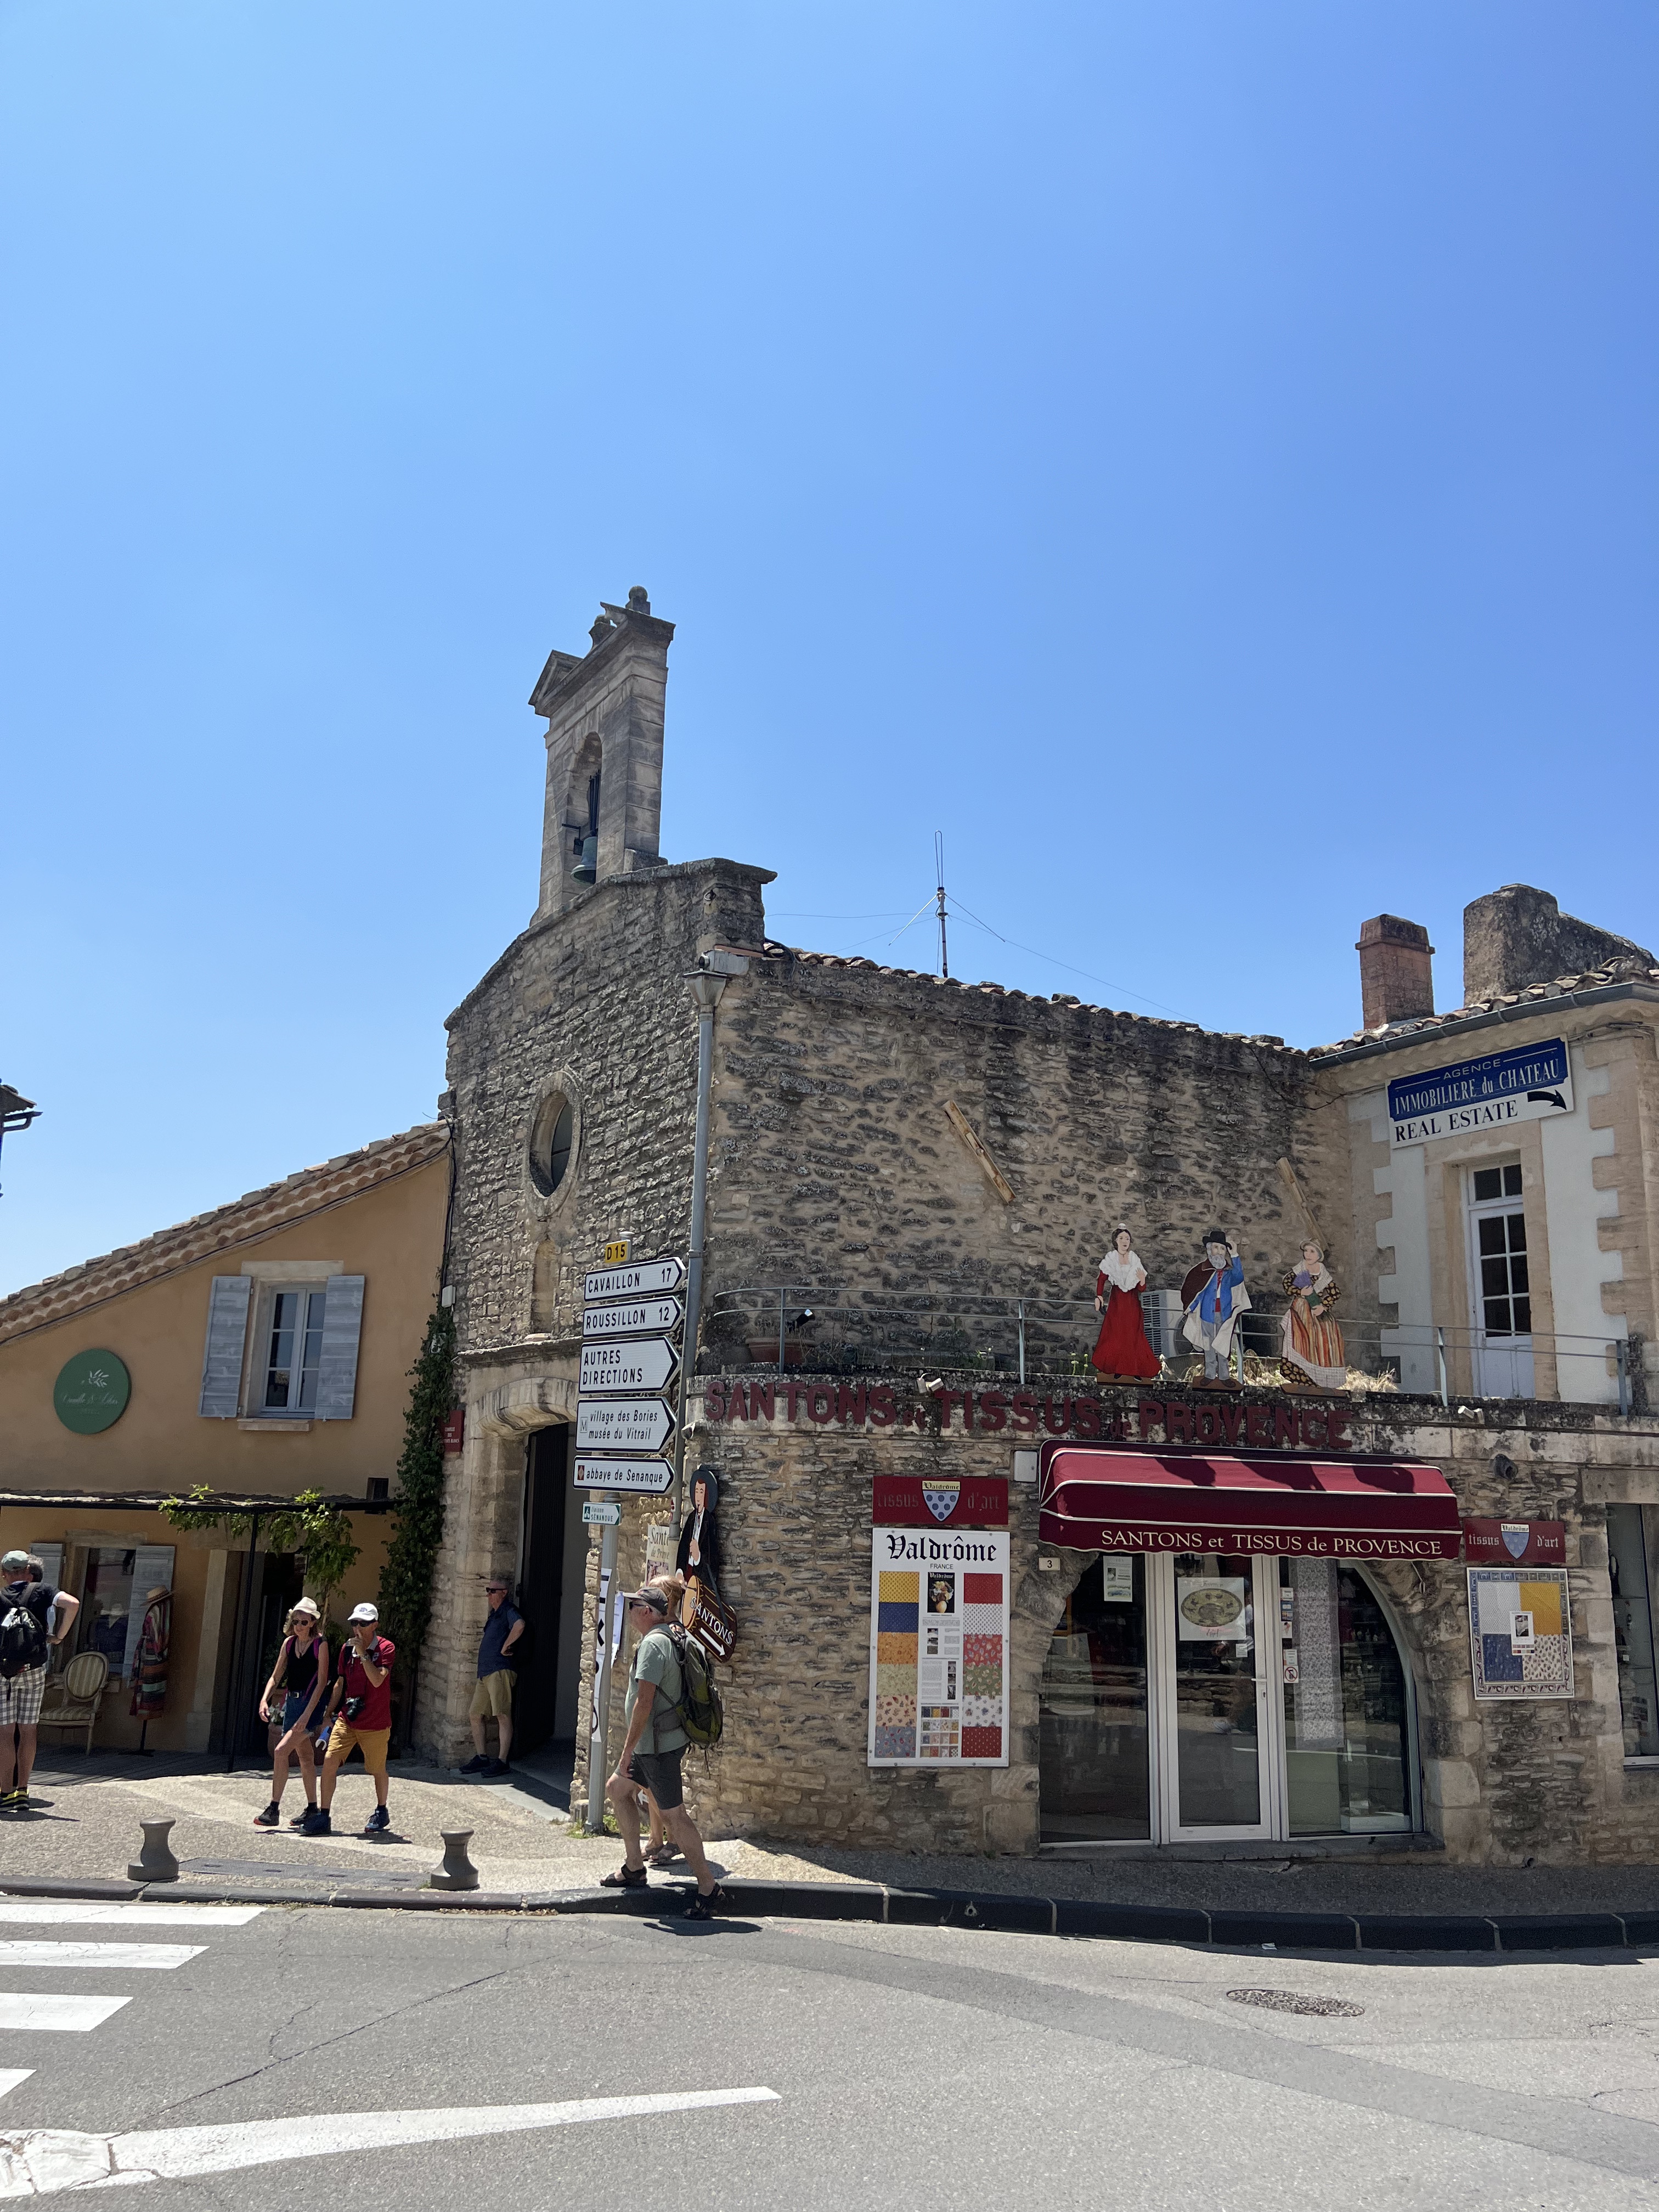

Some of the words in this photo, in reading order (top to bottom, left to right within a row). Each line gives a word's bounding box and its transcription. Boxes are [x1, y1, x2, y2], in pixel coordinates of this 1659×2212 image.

[1443, 1058, 1501, 1080] AGENCE
[1395, 1079, 1477, 1115] IMMOBILIERE
[1481, 1076, 1494, 1094] du
[1499, 1058, 1559, 1090] CHATEAU
[1394, 1118, 1441, 1142] REAL
[1448, 1099, 1518, 1131] ESTATE
[607, 1246, 612, 1260] D
[615, 1244, 625, 1259] 15
[588, 1272, 640, 1294] CAVAILLON
[661, 1267, 672, 1283] 17
[586, 1308, 646, 1329] ROUSSILLON
[659, 1306, 669, 1322] 12
[584, 1350, 621, 1366] AUTRES
[583, 1368, 643, 1385] DIRECTIONS
[590, 1410, 614, 1425] village
[618, 1410, 630, 1422] des
[634, 1409, 658, 1422] Bories
[706, 1380, 897, 1426] SANTONS
[902, 1408, 926, 1430] et
[934, 1389, 1101, 1436] TISSUS
[1138, 1400, 1353, 1448] PROVENCE
[588, 1427, 611, 1439] musée
[614, 1427, 623, 1439] du
[627, 1427, 651, 1440] Vitrail
[586, 1468, 611, 1482] abbaye
[614, 1469, 623, 1481] de
[627, 1469, 663, 1486] Senanque
[886, 1534, 997, 1561] Valdrôme
[1102, 1530, 1203, 1548] SANTONS
[1208, 1537, 1224, 1548] et
[1232, 1534, 1302, 1550] TISSUS
[1307, 1537, 1328, 1551] de
[1333, 1538, 1442, 1555] PROVENCE
[1468, 1533, 1499, 1545] tissus
[1537, 1534, 1559, 1548] d'art
[1047, 1560, 1053, 1568] 3
[690, 1596, 733, 1645] SANTONS
